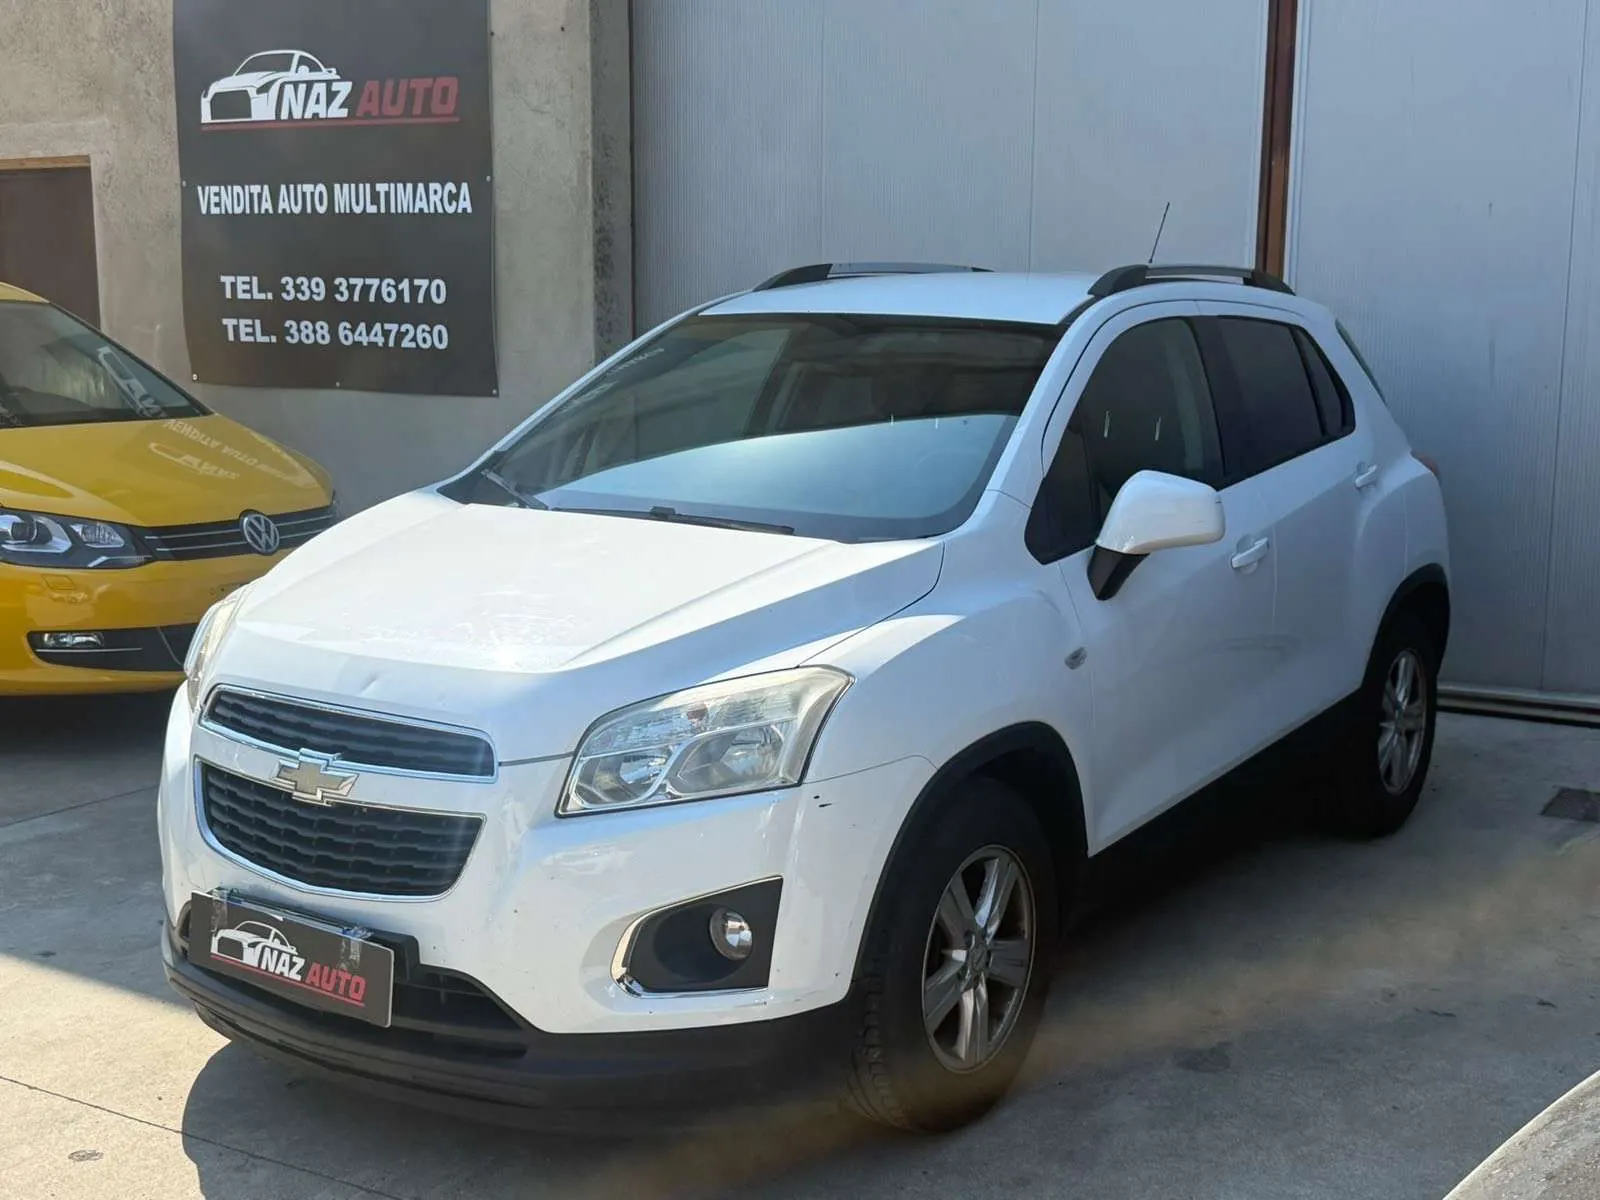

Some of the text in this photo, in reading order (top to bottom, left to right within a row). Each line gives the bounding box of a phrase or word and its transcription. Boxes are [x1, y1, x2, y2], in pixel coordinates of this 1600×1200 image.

[281, 77, 458, 120] NAZ AUTO
[197, 182, 473, 215] VENDITA AUTO MULTIMARCA
[220, 275, 447, 304] TEL. 339 3776170
[222, 318, 449, 349] TEL. 388 6447260
[261, 947, 366, 1000] NAZ AUTO
